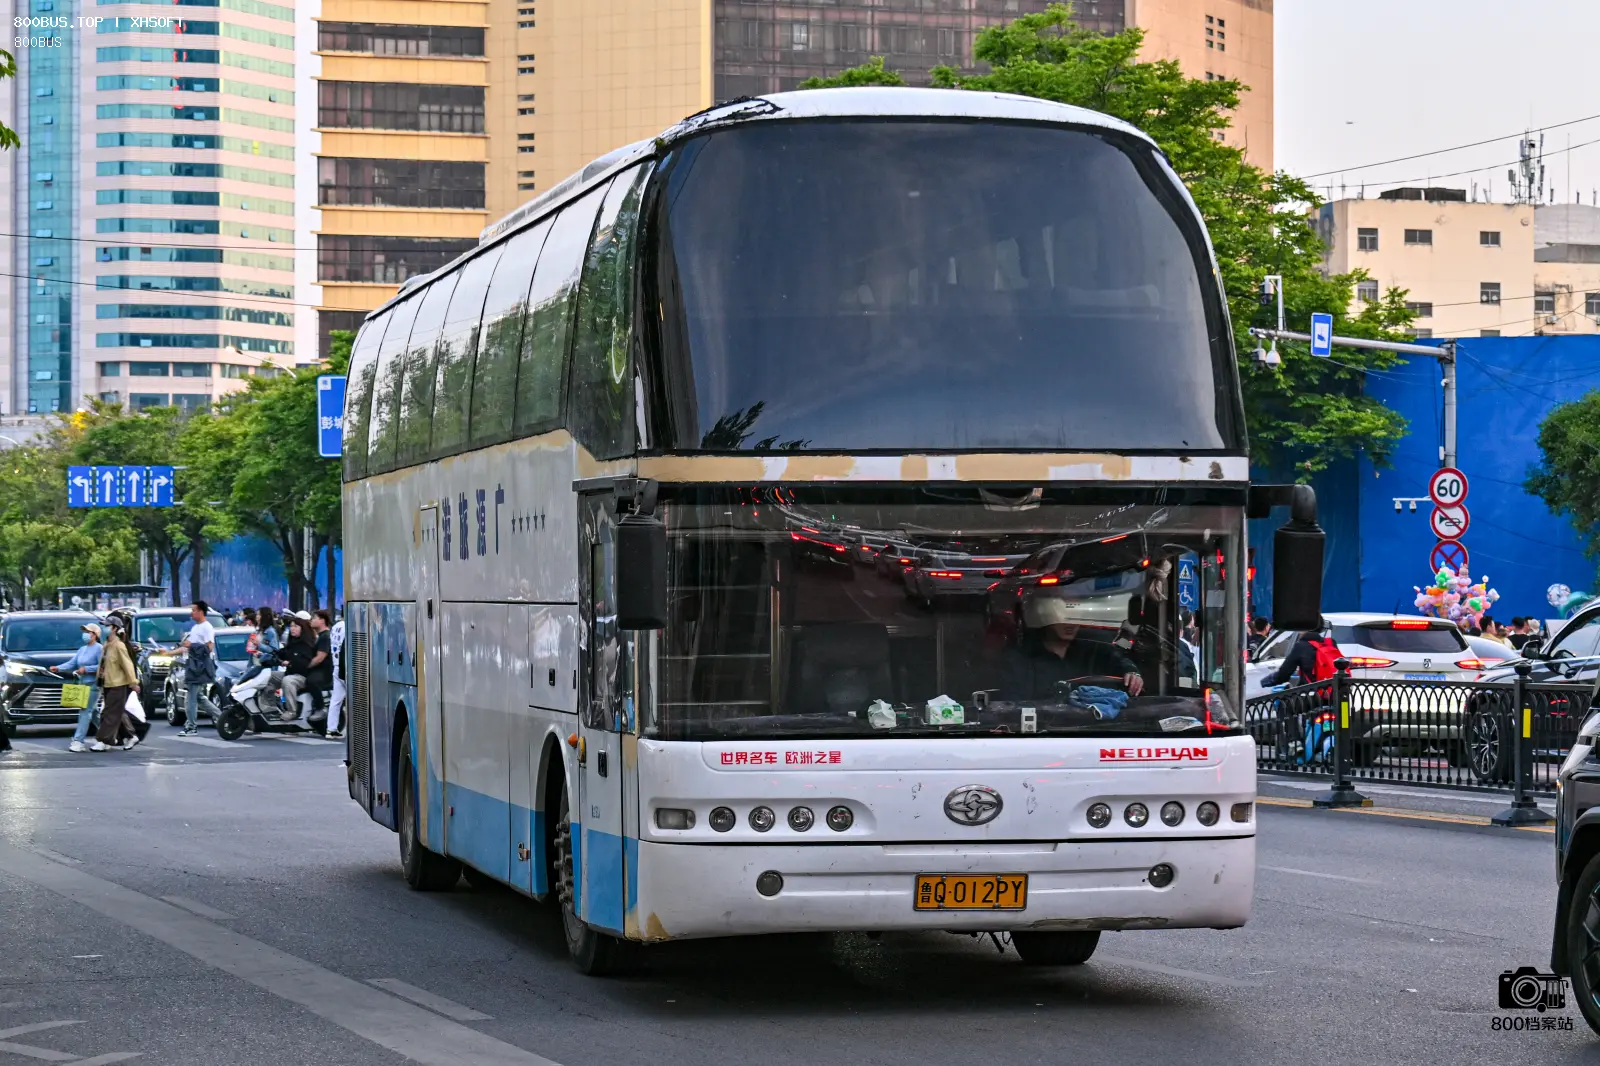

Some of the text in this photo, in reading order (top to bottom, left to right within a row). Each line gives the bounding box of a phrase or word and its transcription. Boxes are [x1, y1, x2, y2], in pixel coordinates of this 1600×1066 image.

[1436, 478, 1460, 498] 60
[720, 751, 842, 765] 世界名车 欧洲之星
[1099, 747, 1209, 762] NEOPLAN
